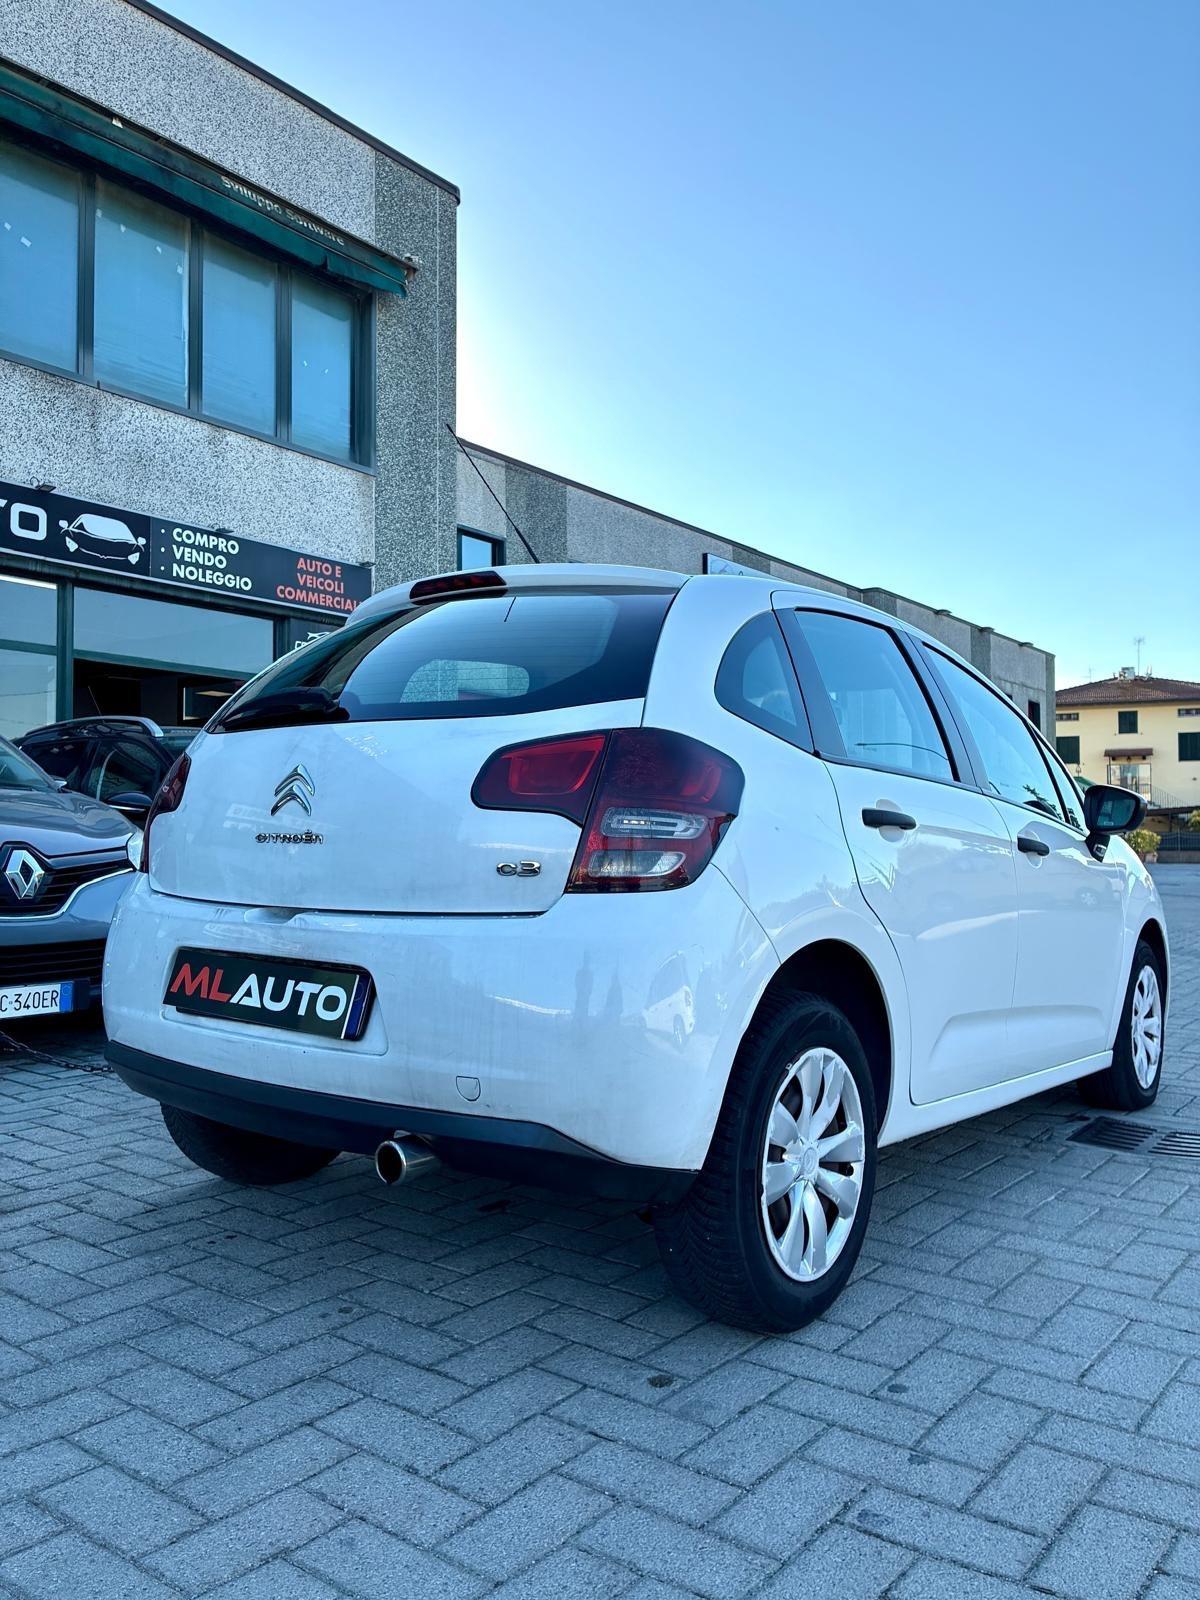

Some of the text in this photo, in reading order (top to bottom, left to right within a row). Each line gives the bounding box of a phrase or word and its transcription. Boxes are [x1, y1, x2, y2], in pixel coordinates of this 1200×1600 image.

[172, 527, 240, 555] COMPRO
[172, 545, 227, 569] VENDO
[297, 557, 342, 578] AUTO E
[172, 564, 252, 591] NOLEGGIO
[297, 573, 344, 594] VEICOLI
[276, 585, 363, 612] COMMERCIA
[496, 860, 541, 877] C3
